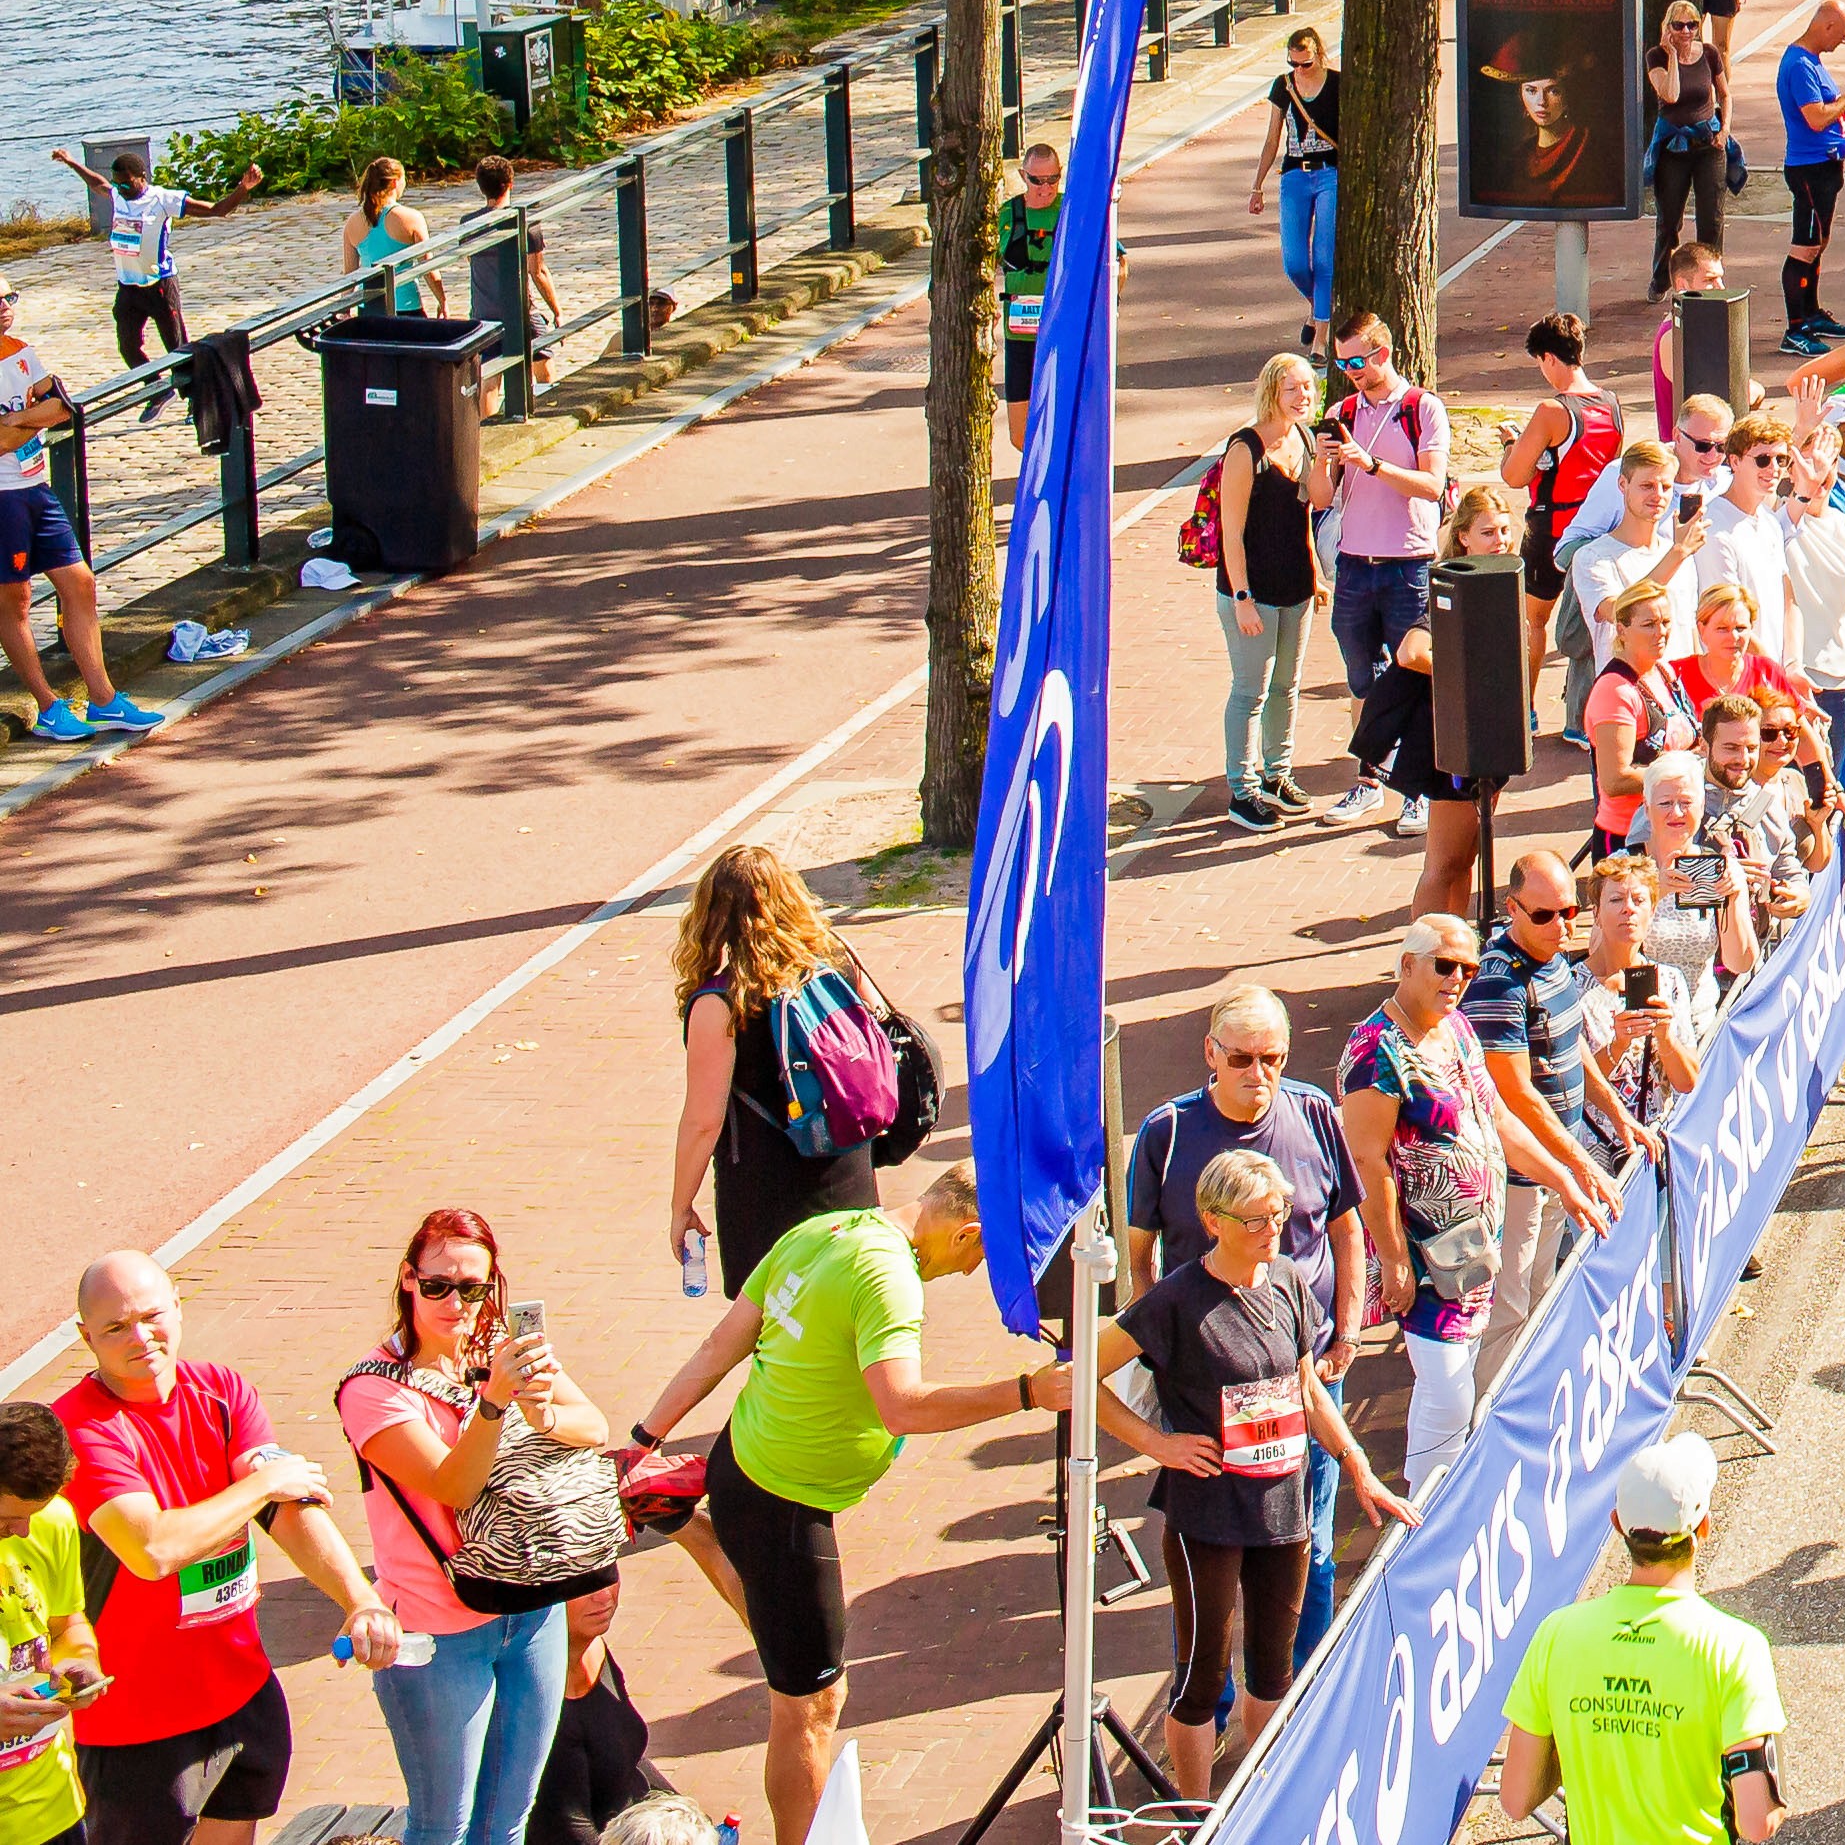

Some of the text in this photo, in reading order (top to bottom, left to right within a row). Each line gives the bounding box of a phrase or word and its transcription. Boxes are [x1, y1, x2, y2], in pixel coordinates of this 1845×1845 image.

[1257, 1420, 1279, 1441] RIA
[1429, 1461, 1535, 1746] asics
[1603, 1675, 1655, 1695] TATA
[1568, 1695, 1687, 1721] CONSULTANCY
[1592, 1715, 1662, 1739] SERVICES
